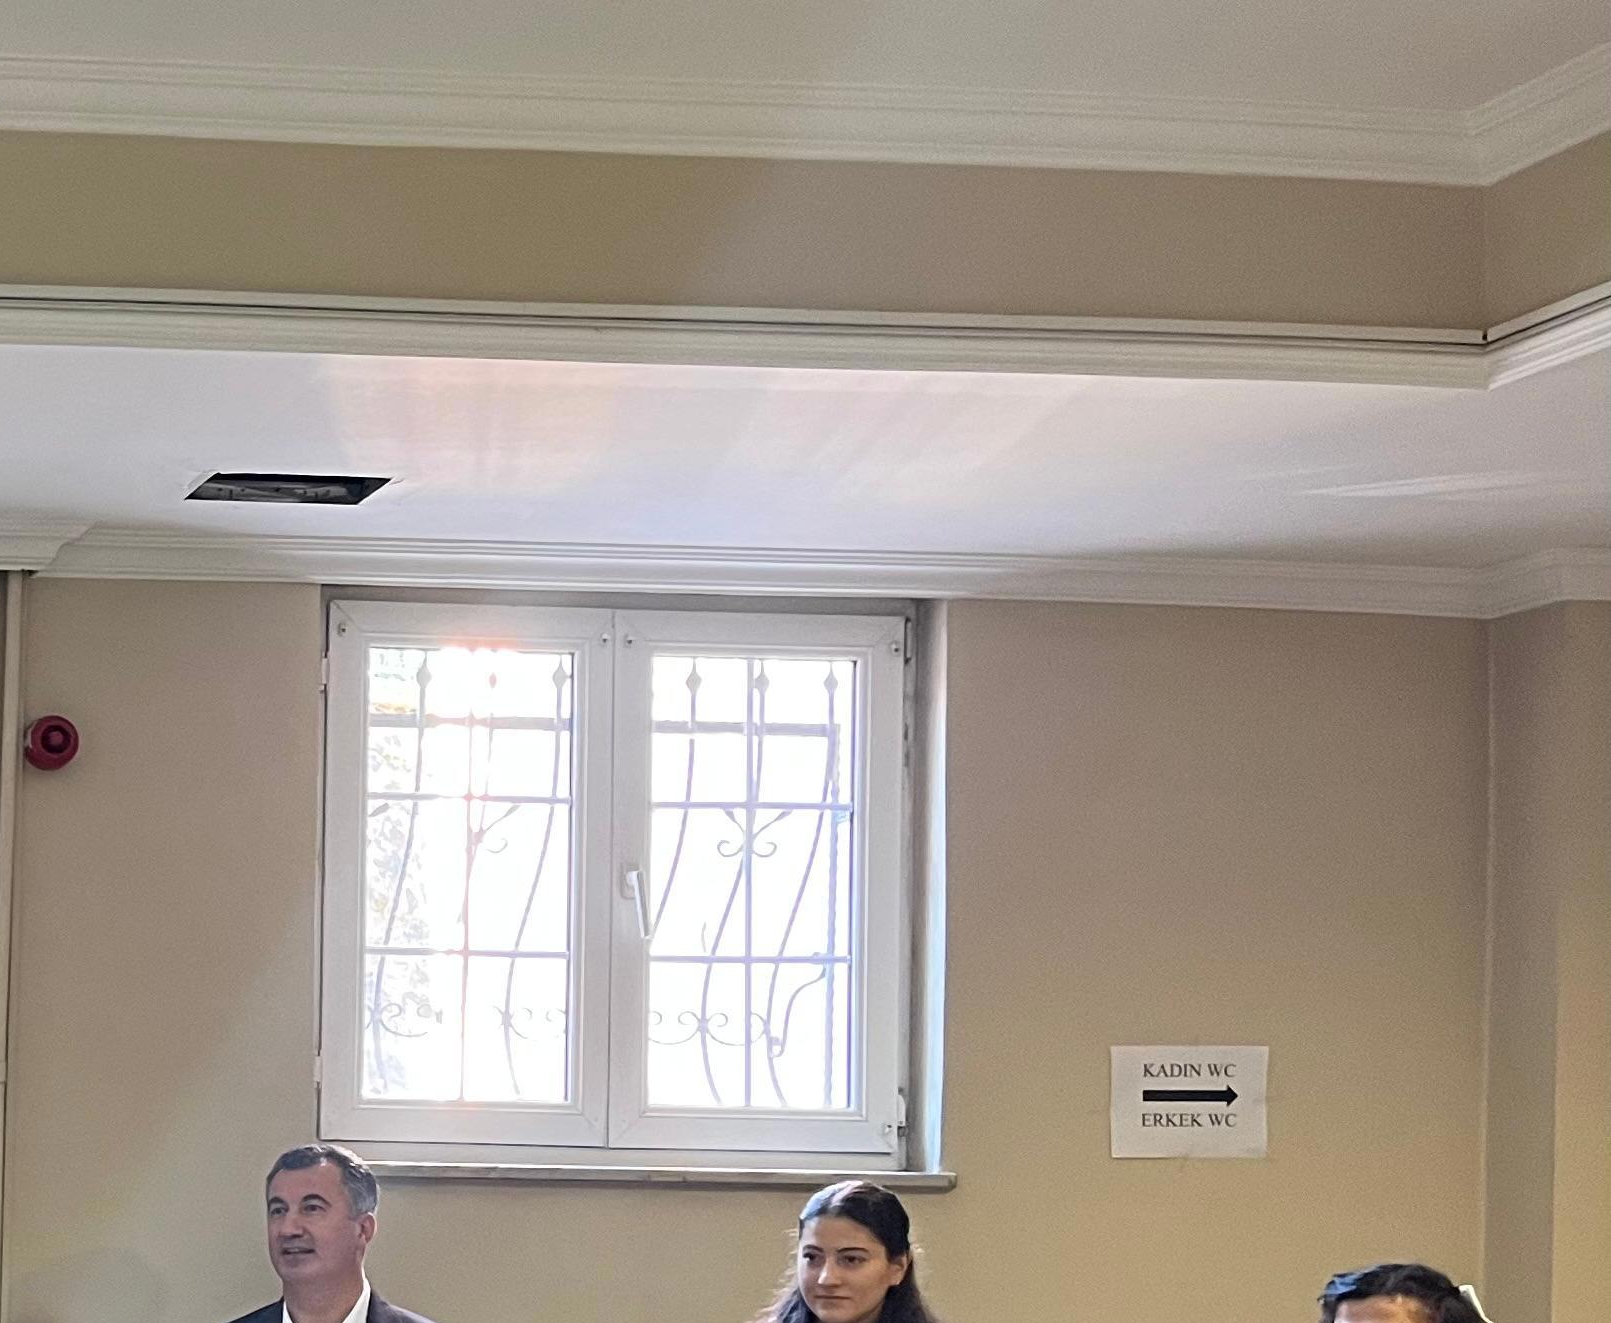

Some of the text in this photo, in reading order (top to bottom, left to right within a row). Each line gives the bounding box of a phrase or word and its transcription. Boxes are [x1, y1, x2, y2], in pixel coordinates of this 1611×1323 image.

[1142, 1063, 1237, 1078] KADIN WC
[1141, 1112, 1237, 1128] ERKEK WC
